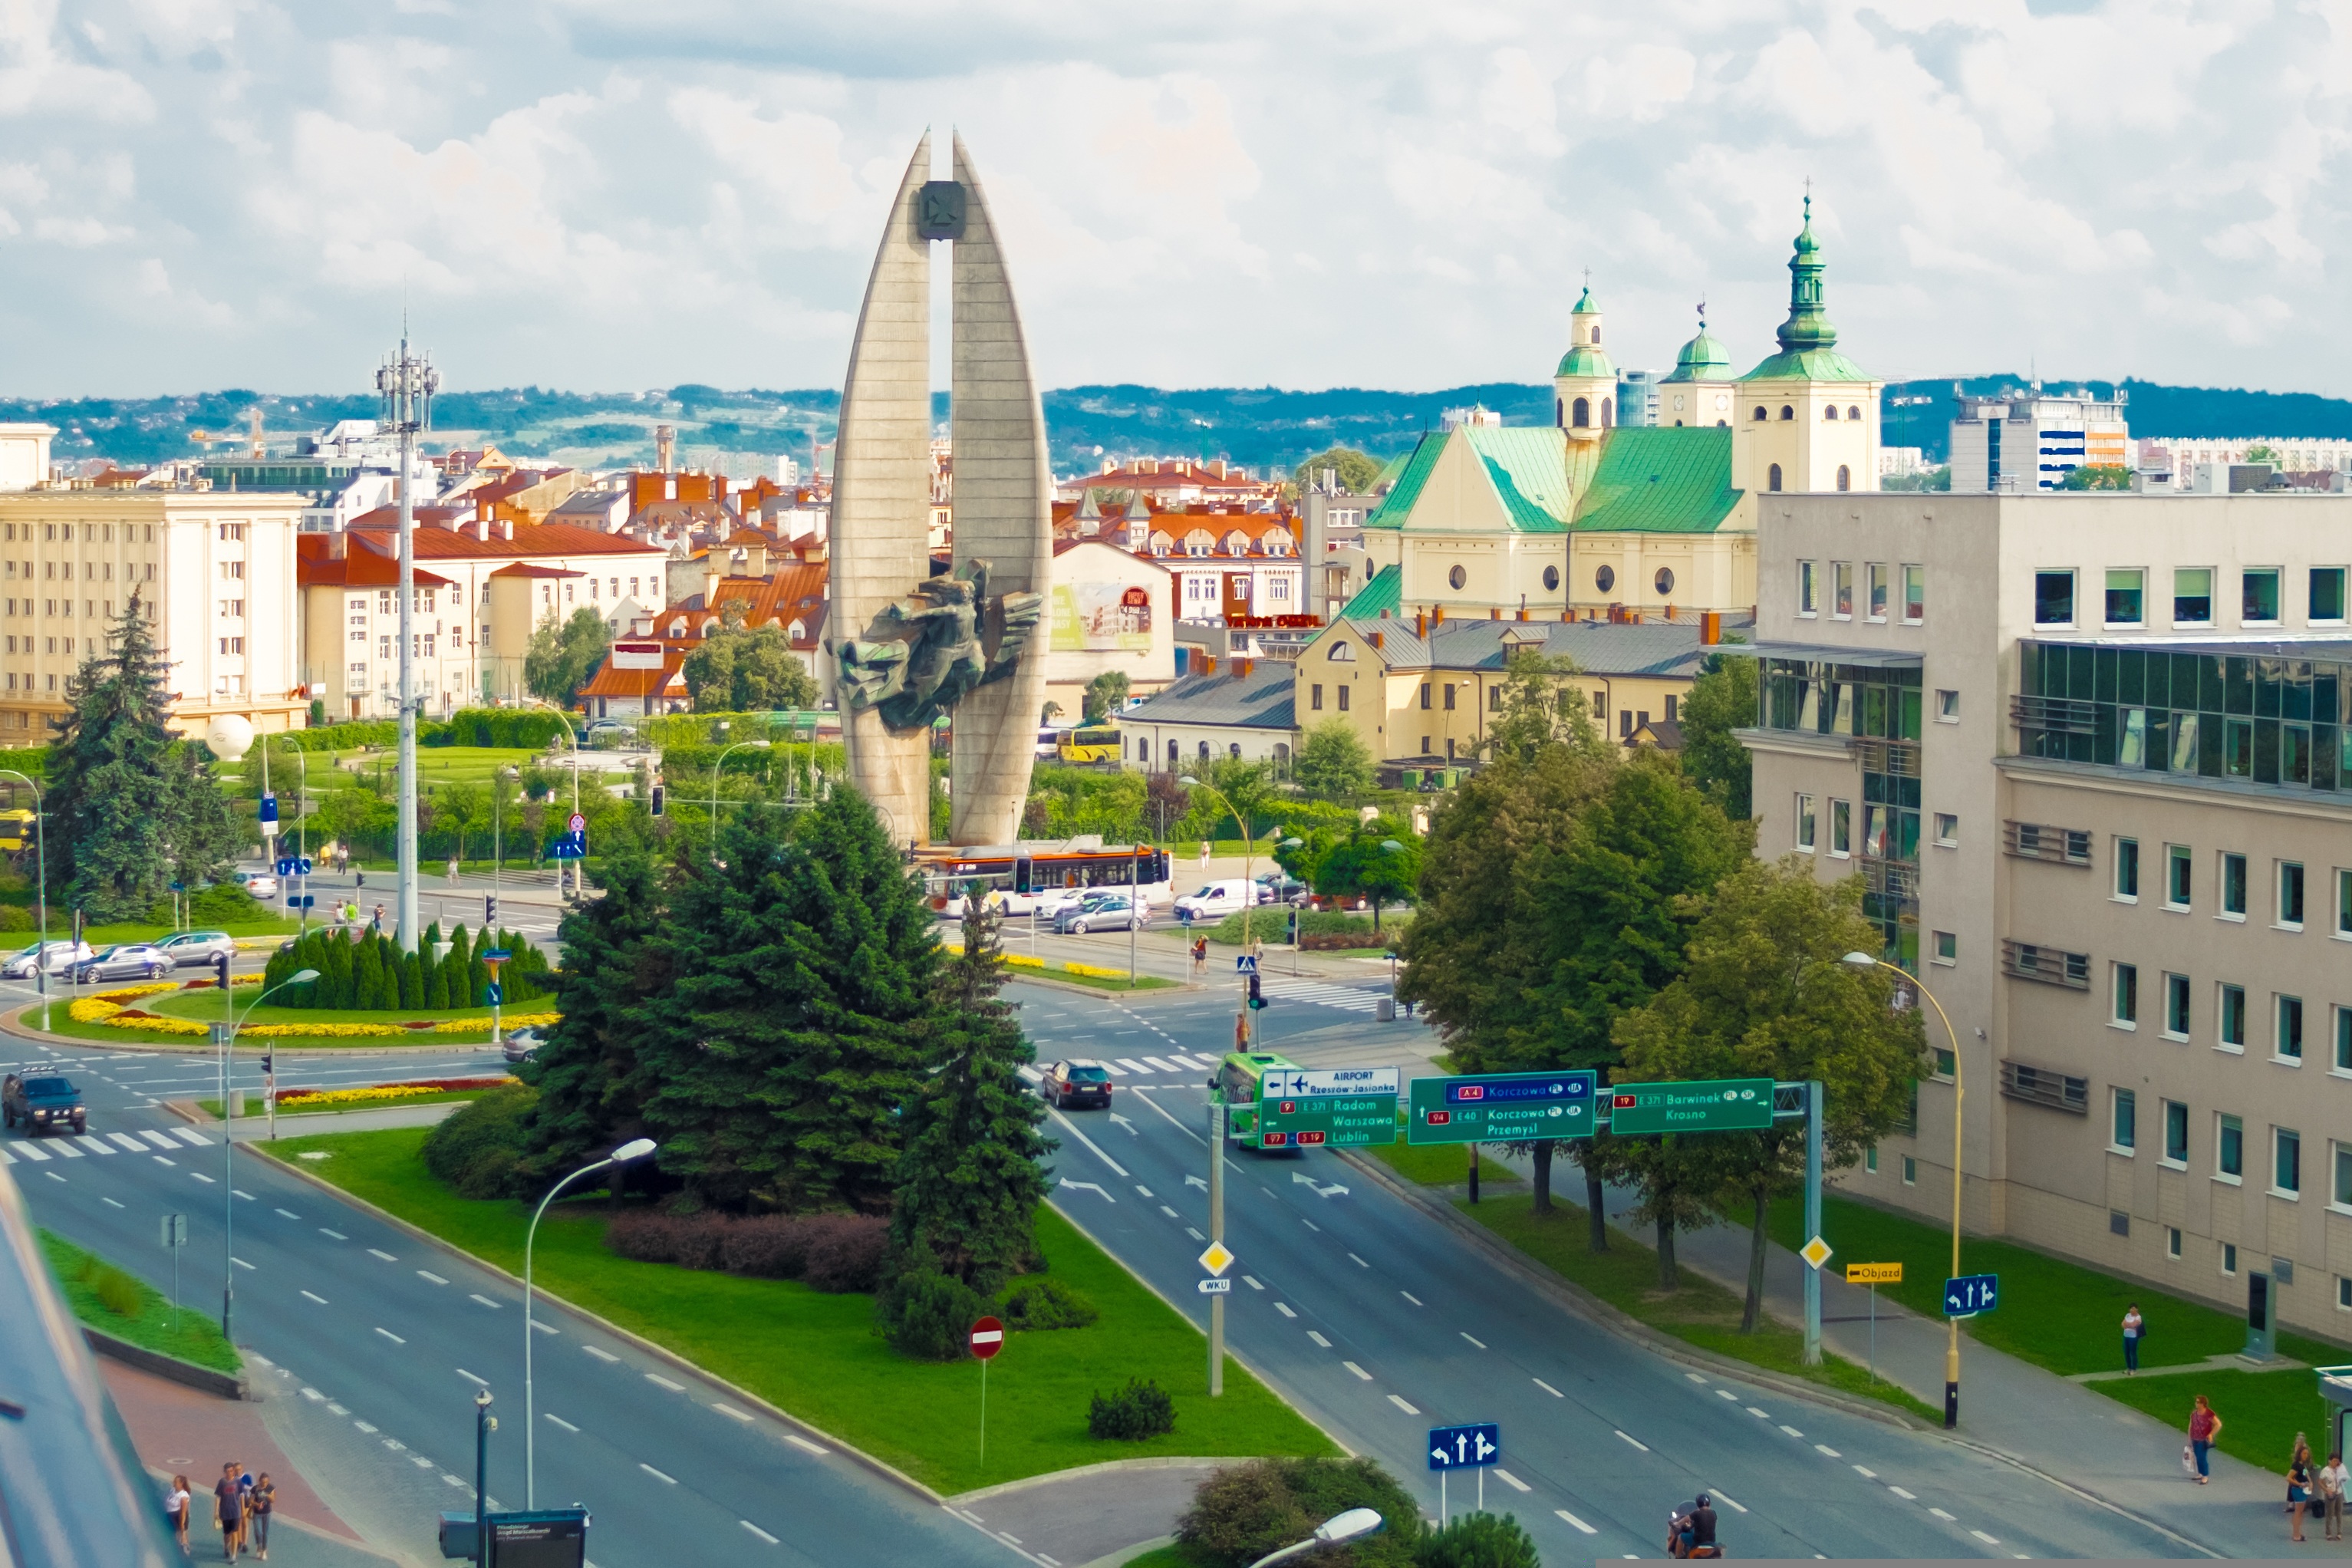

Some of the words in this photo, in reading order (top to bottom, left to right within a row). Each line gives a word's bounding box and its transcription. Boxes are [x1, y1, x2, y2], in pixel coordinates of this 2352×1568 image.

[1333, 1071, 1373, 1081] AIRPORT
[1463, 1089, 1470, 1097] A
[1472, 1088, 1477, 1096] 4
[1489, 1086, 1546, 1097] Korczowa
[1647, 1095, 1661, 1105] 371
[1667, 1092, 1720, 1104] Barwinek
[1285, 1102, 1290, 1111] 9
[1313, 1102, 1326, 1111] 371
[1334, 1100, 1376, 1111] Radom
[1333, 1115, 1393, 1126] Warszawa
[1458, 1112, 1463, 1121] E
[1464, 1112, 1476, 1120] 40
[1488, 1109, 1545, 1120] Korczowa
[1666, 1110, 1706, 1121] Krosno
[1310, 1133, 1320, 1141] 19
[1332, 1132, 1369, 1142] Lublin
[1861, 1268, 1900, 1280] Objazd
[1206, 1281, 1227, 1290] WKU
